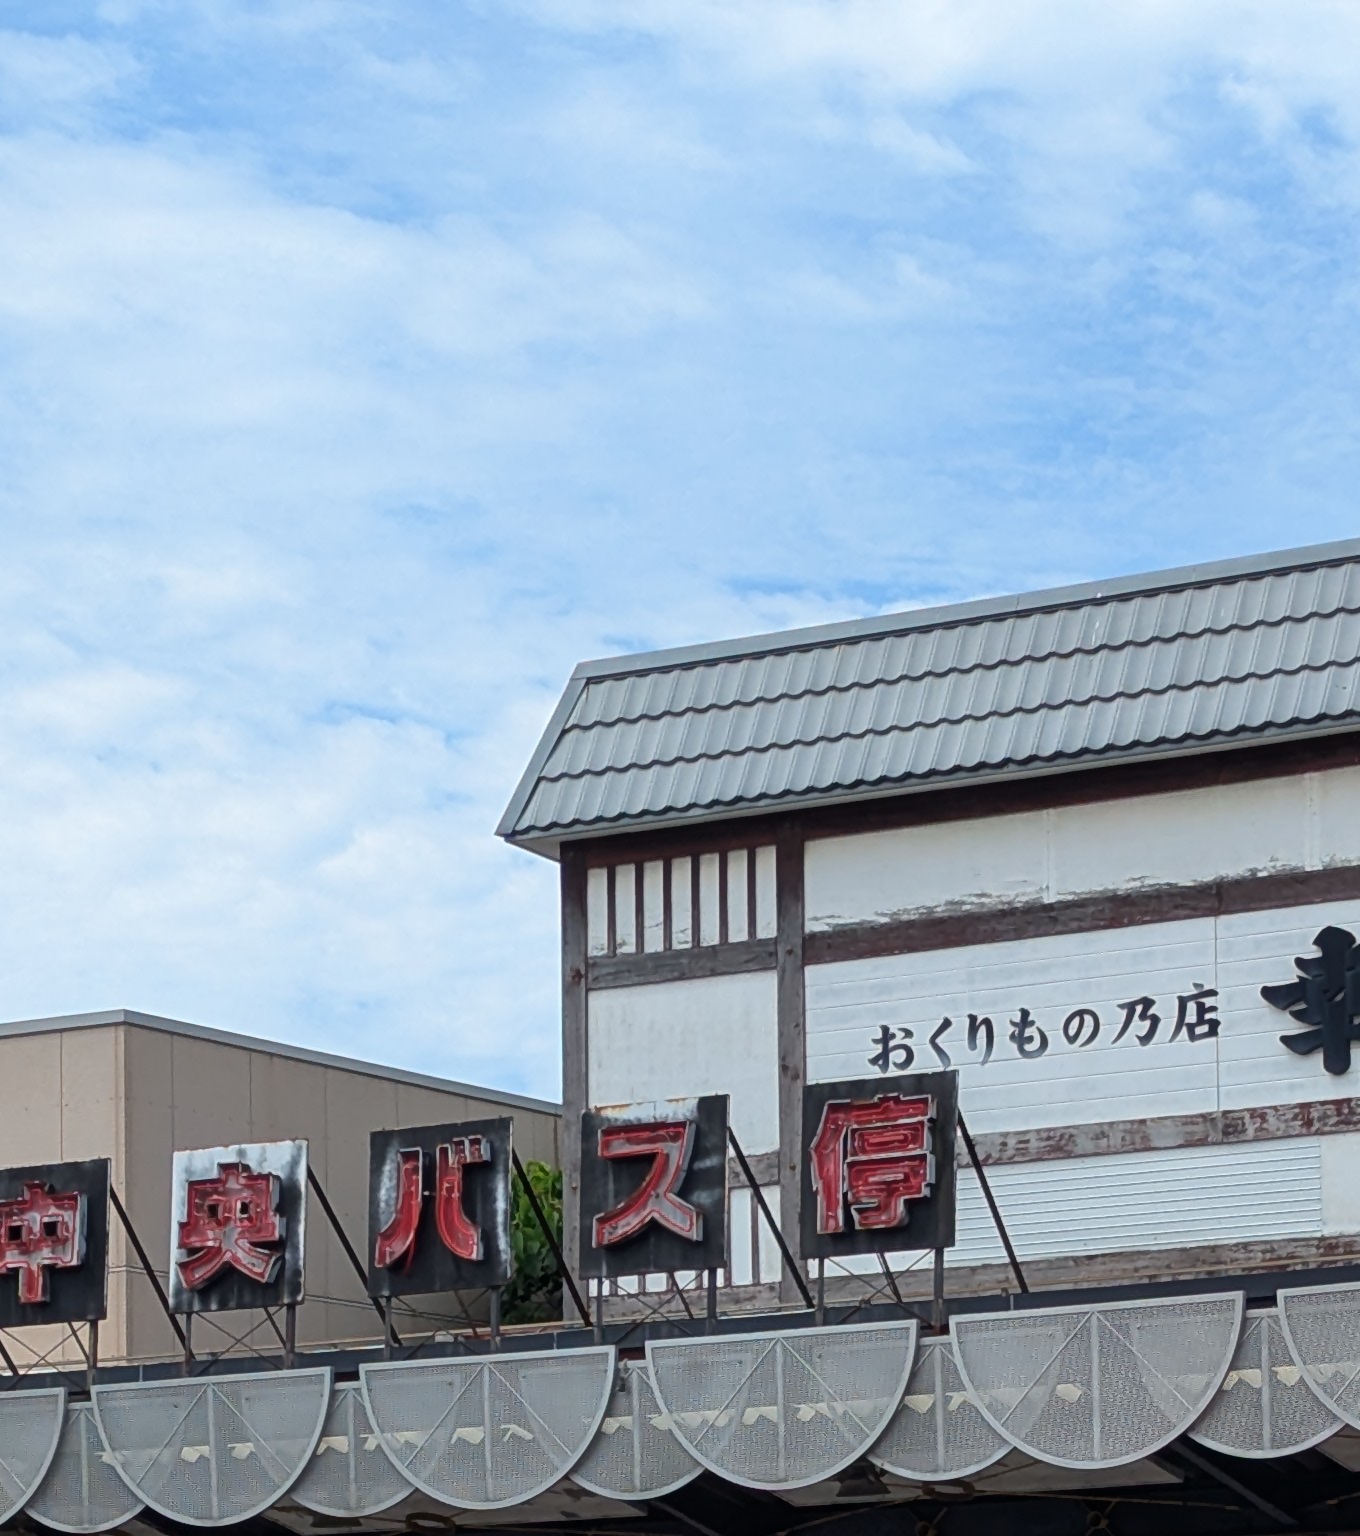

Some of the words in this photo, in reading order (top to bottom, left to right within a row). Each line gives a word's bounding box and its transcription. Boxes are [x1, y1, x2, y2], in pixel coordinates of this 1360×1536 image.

[867, 983, 1221, 1073] おくりもの乃店
